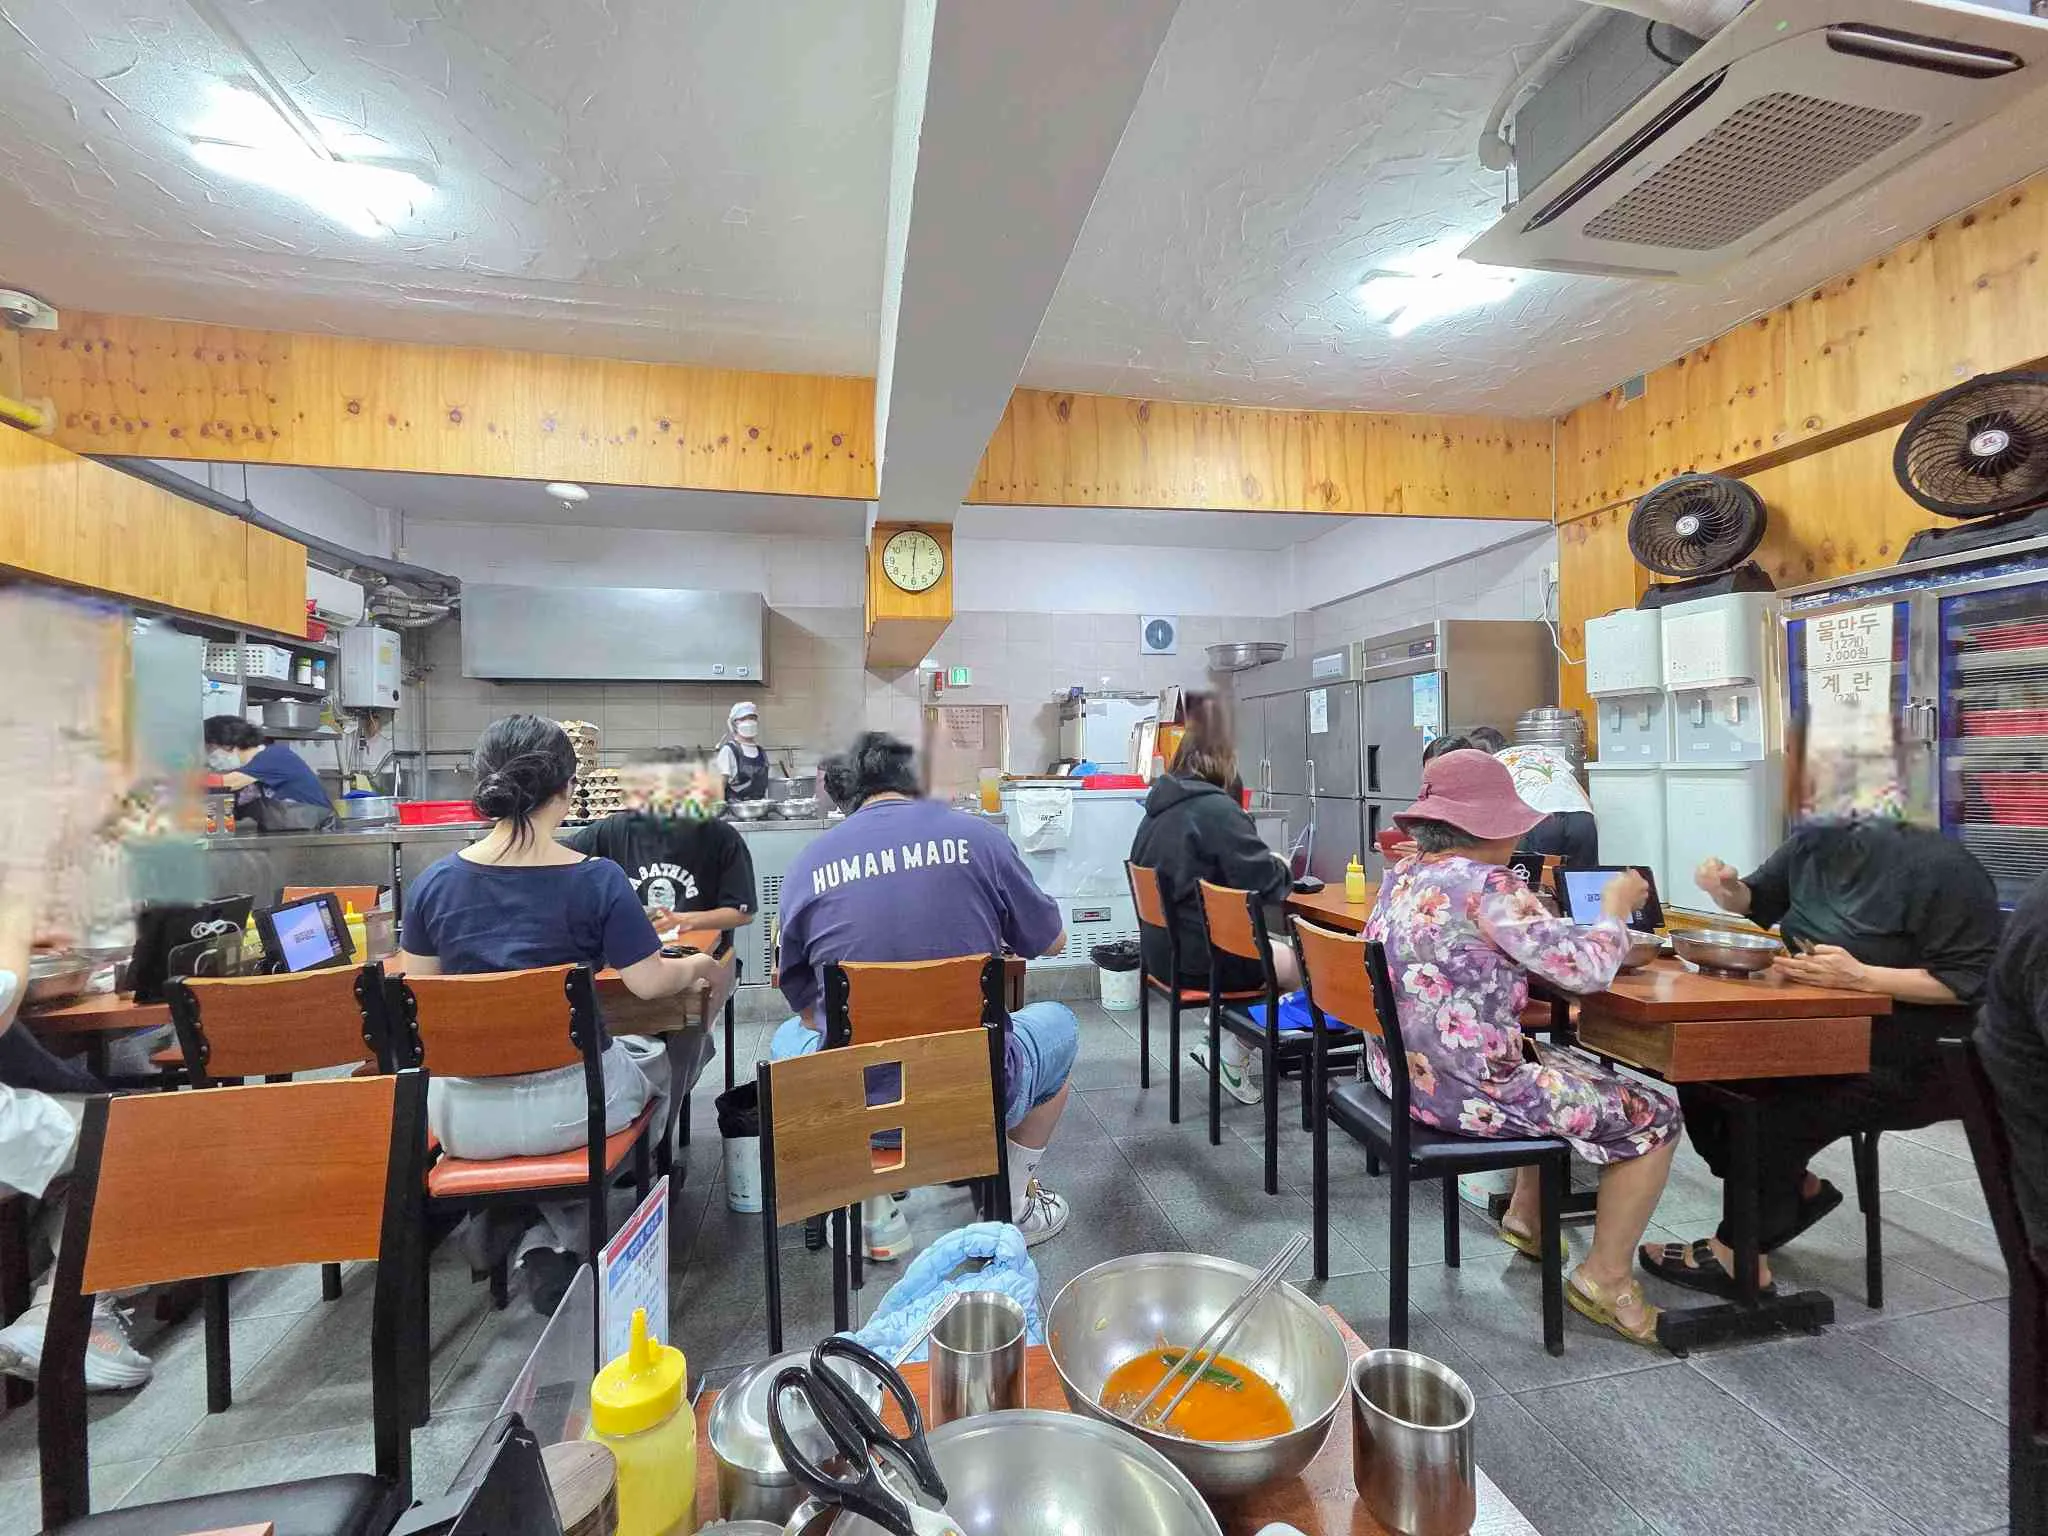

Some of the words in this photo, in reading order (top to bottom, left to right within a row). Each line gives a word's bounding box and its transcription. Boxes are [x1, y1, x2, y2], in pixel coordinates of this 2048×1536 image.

[911, 576, 917, 585] 6
[921, 575, 928, 583] 5
[1816, 612, 1880, 642] 물만두
[1830, 636, 1864, 651] (12개)
[1824, 647, 1869, 662] 3,000원
[812, 848, 896, 895] HUMAN
[902, 838, 970, 870] MADE
[638, 862, 699, 899] BATHING
